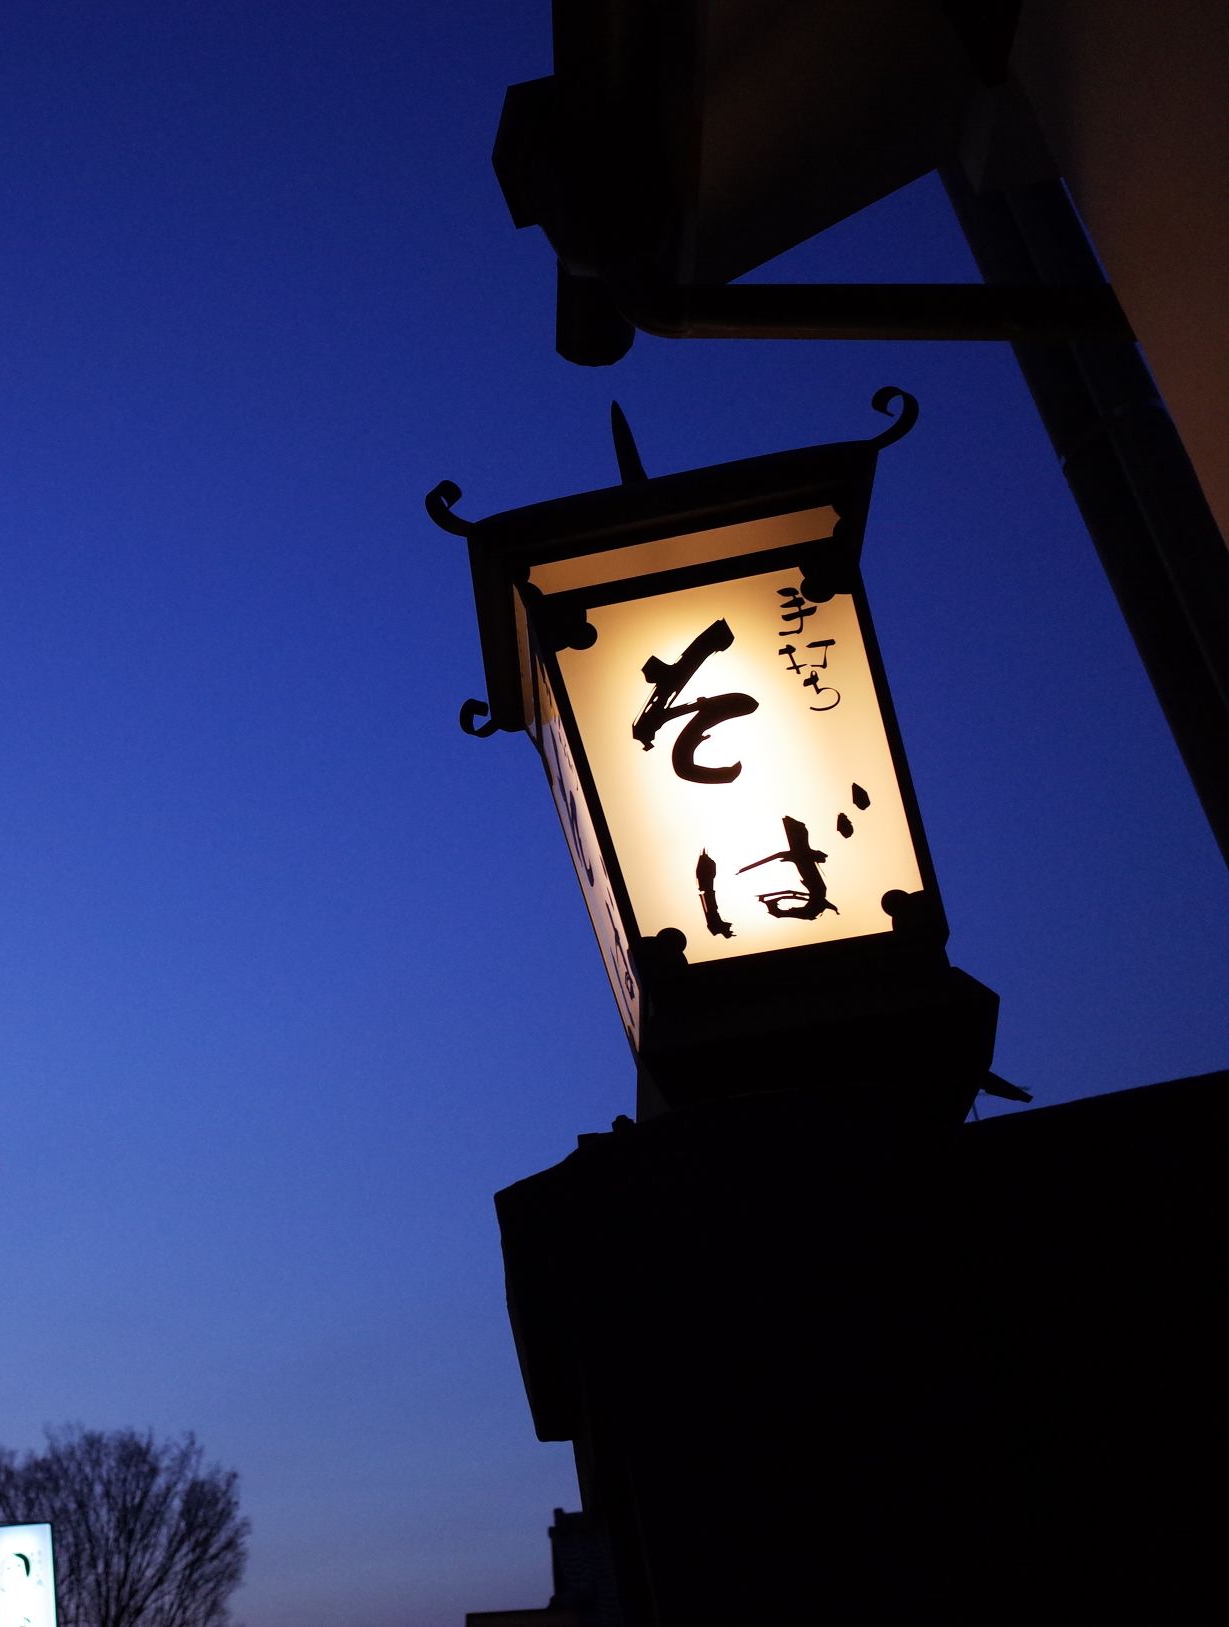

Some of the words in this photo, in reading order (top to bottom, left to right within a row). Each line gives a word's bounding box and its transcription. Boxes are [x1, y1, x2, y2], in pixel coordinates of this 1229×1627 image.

[775, 586, 841, 712] 手打ち
[632, 616, 871, 939] そば
